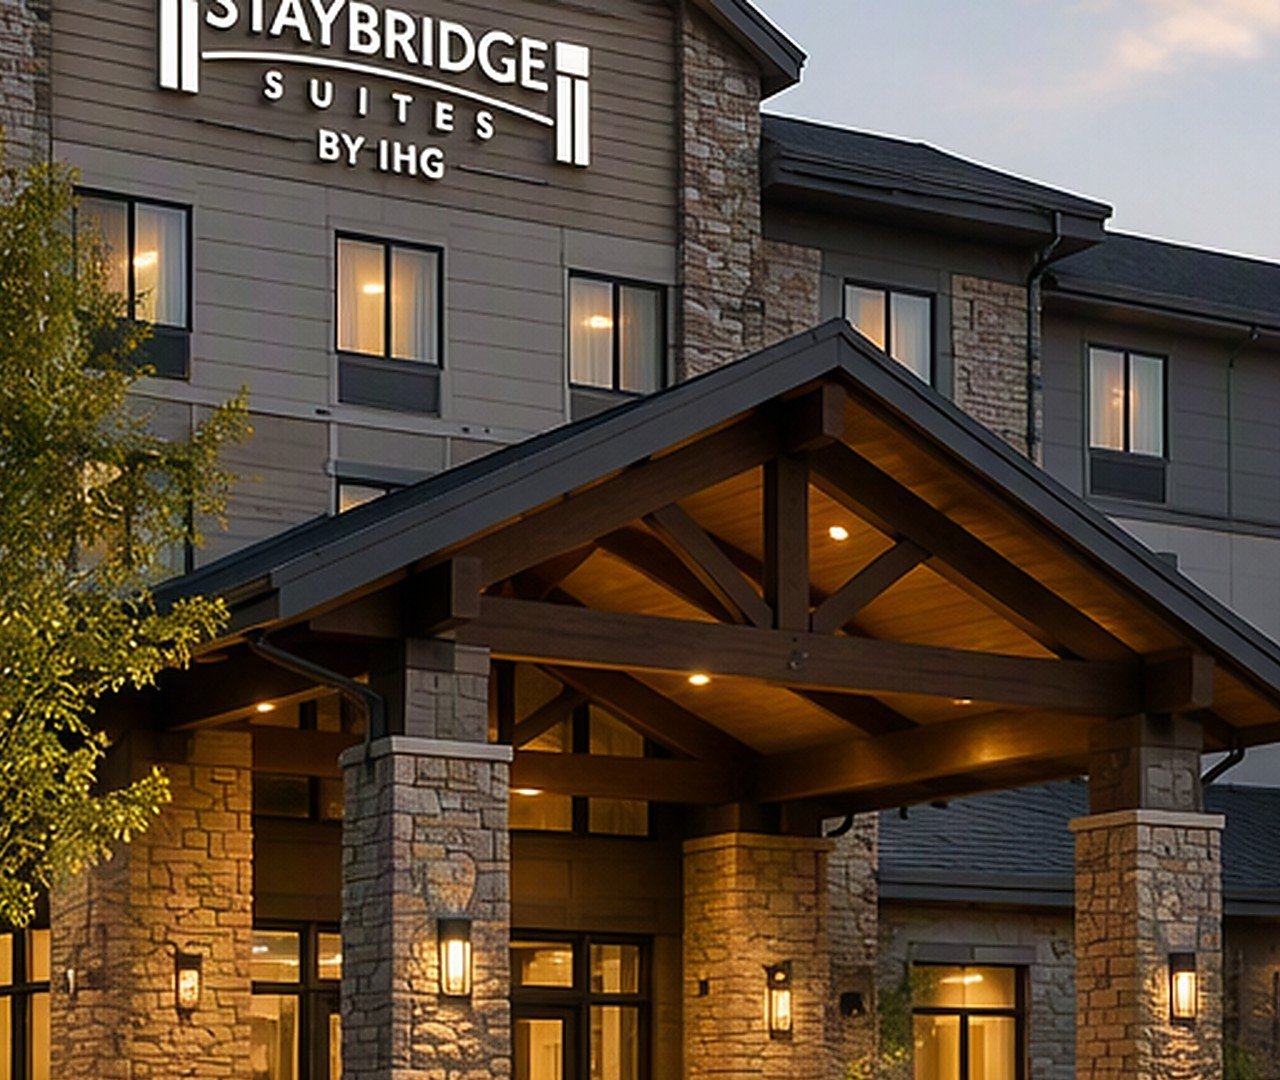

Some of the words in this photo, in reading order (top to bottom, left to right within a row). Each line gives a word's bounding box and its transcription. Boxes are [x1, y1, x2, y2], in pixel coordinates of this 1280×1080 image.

[264, 70, 494, 139] SUITES
[319, 128, 365, 165] BY
[380, 139, 444, 179] IHG
